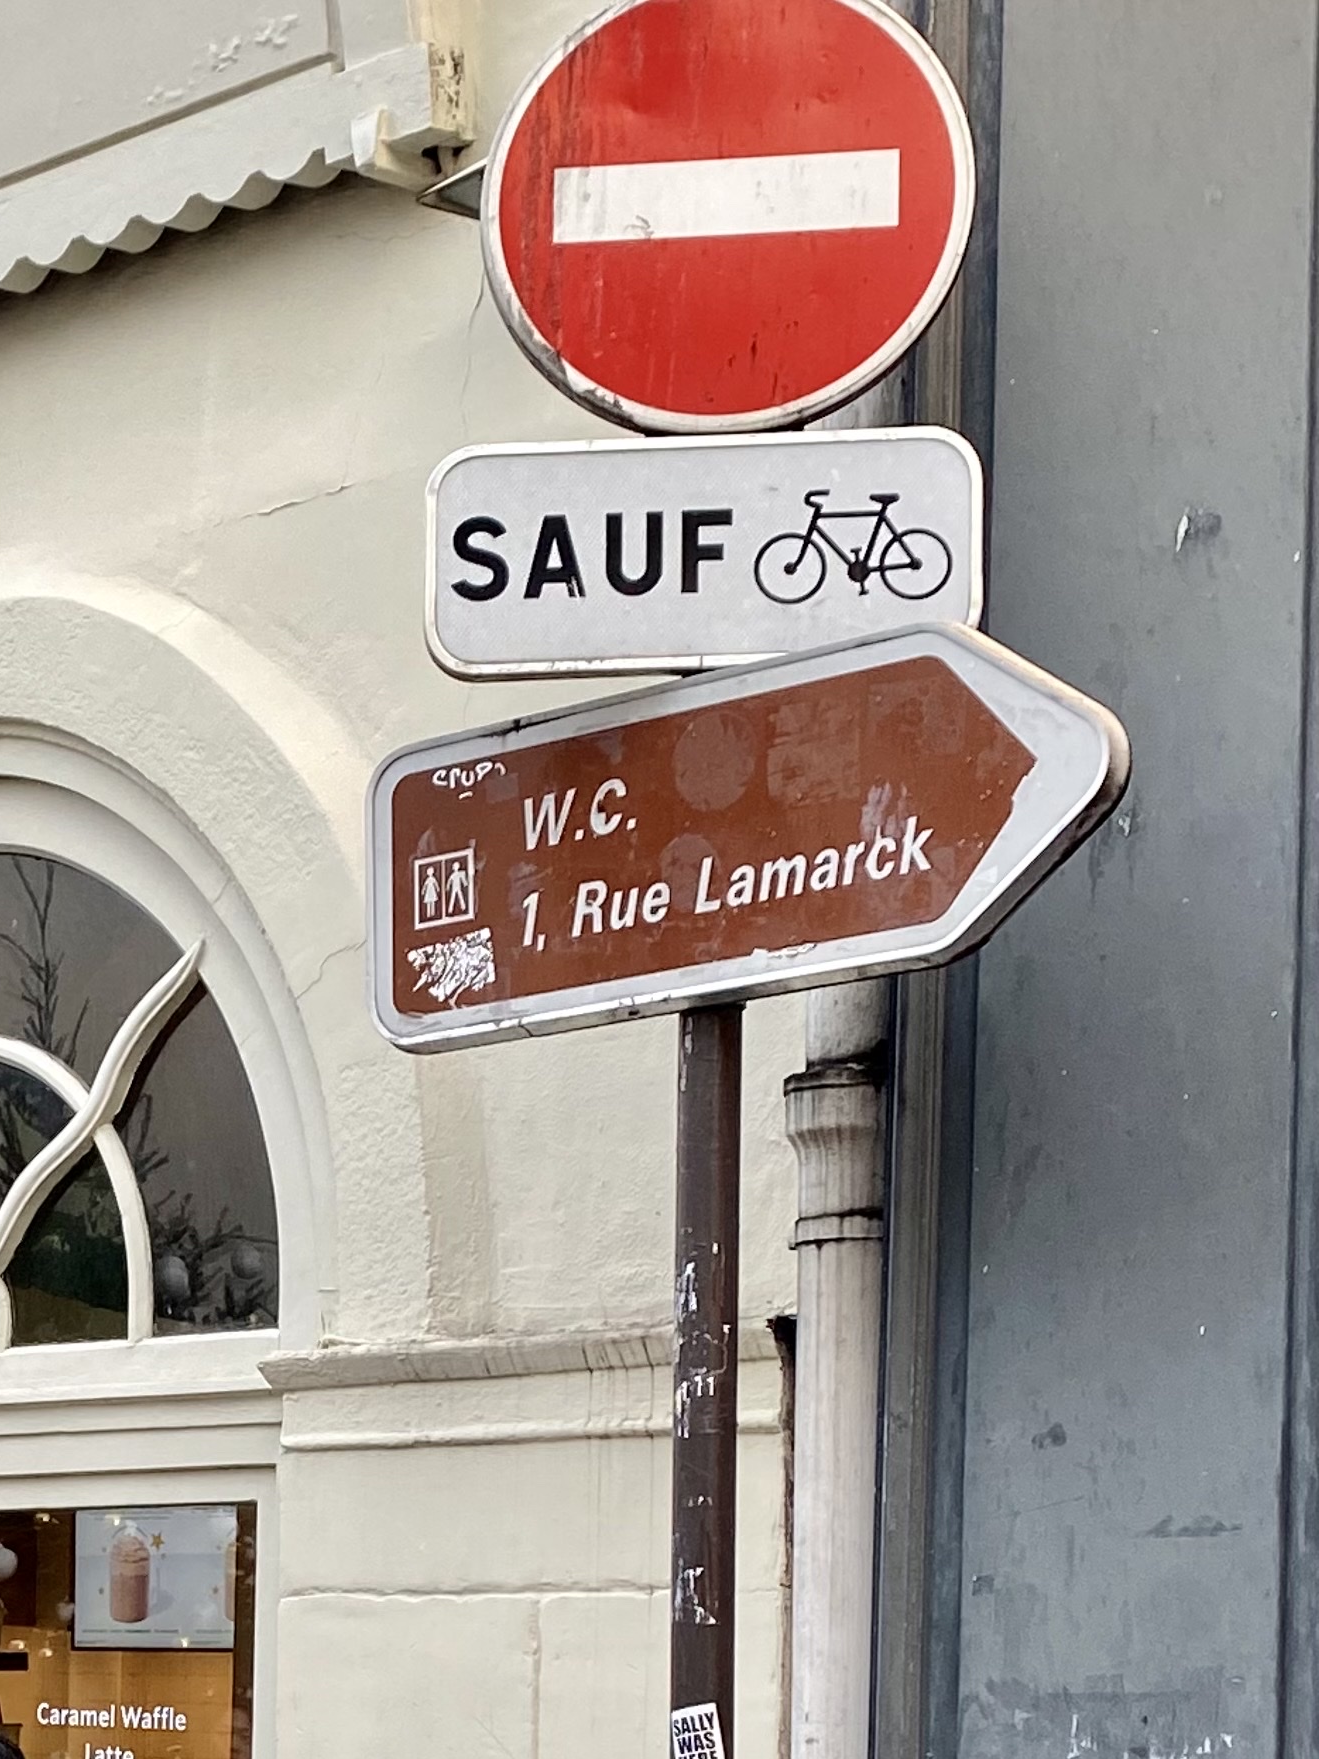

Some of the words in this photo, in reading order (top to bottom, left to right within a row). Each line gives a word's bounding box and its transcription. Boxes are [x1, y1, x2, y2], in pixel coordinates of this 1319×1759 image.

[450, 507, 734, 602] SAUF
[523, 777, 637, 851] W.C.
[522, 891, 546, 952] 1,
[571, 879, 671, 938] Rue
[693, 815, 934, 915] Lamarck
[36, 1702, 115, 1728] Caramel
[120, 1704, 187, 1731] Waffle
[673, 1711, 714, 1738] SALLY
[677, 1731, 716, 1755] WAS
